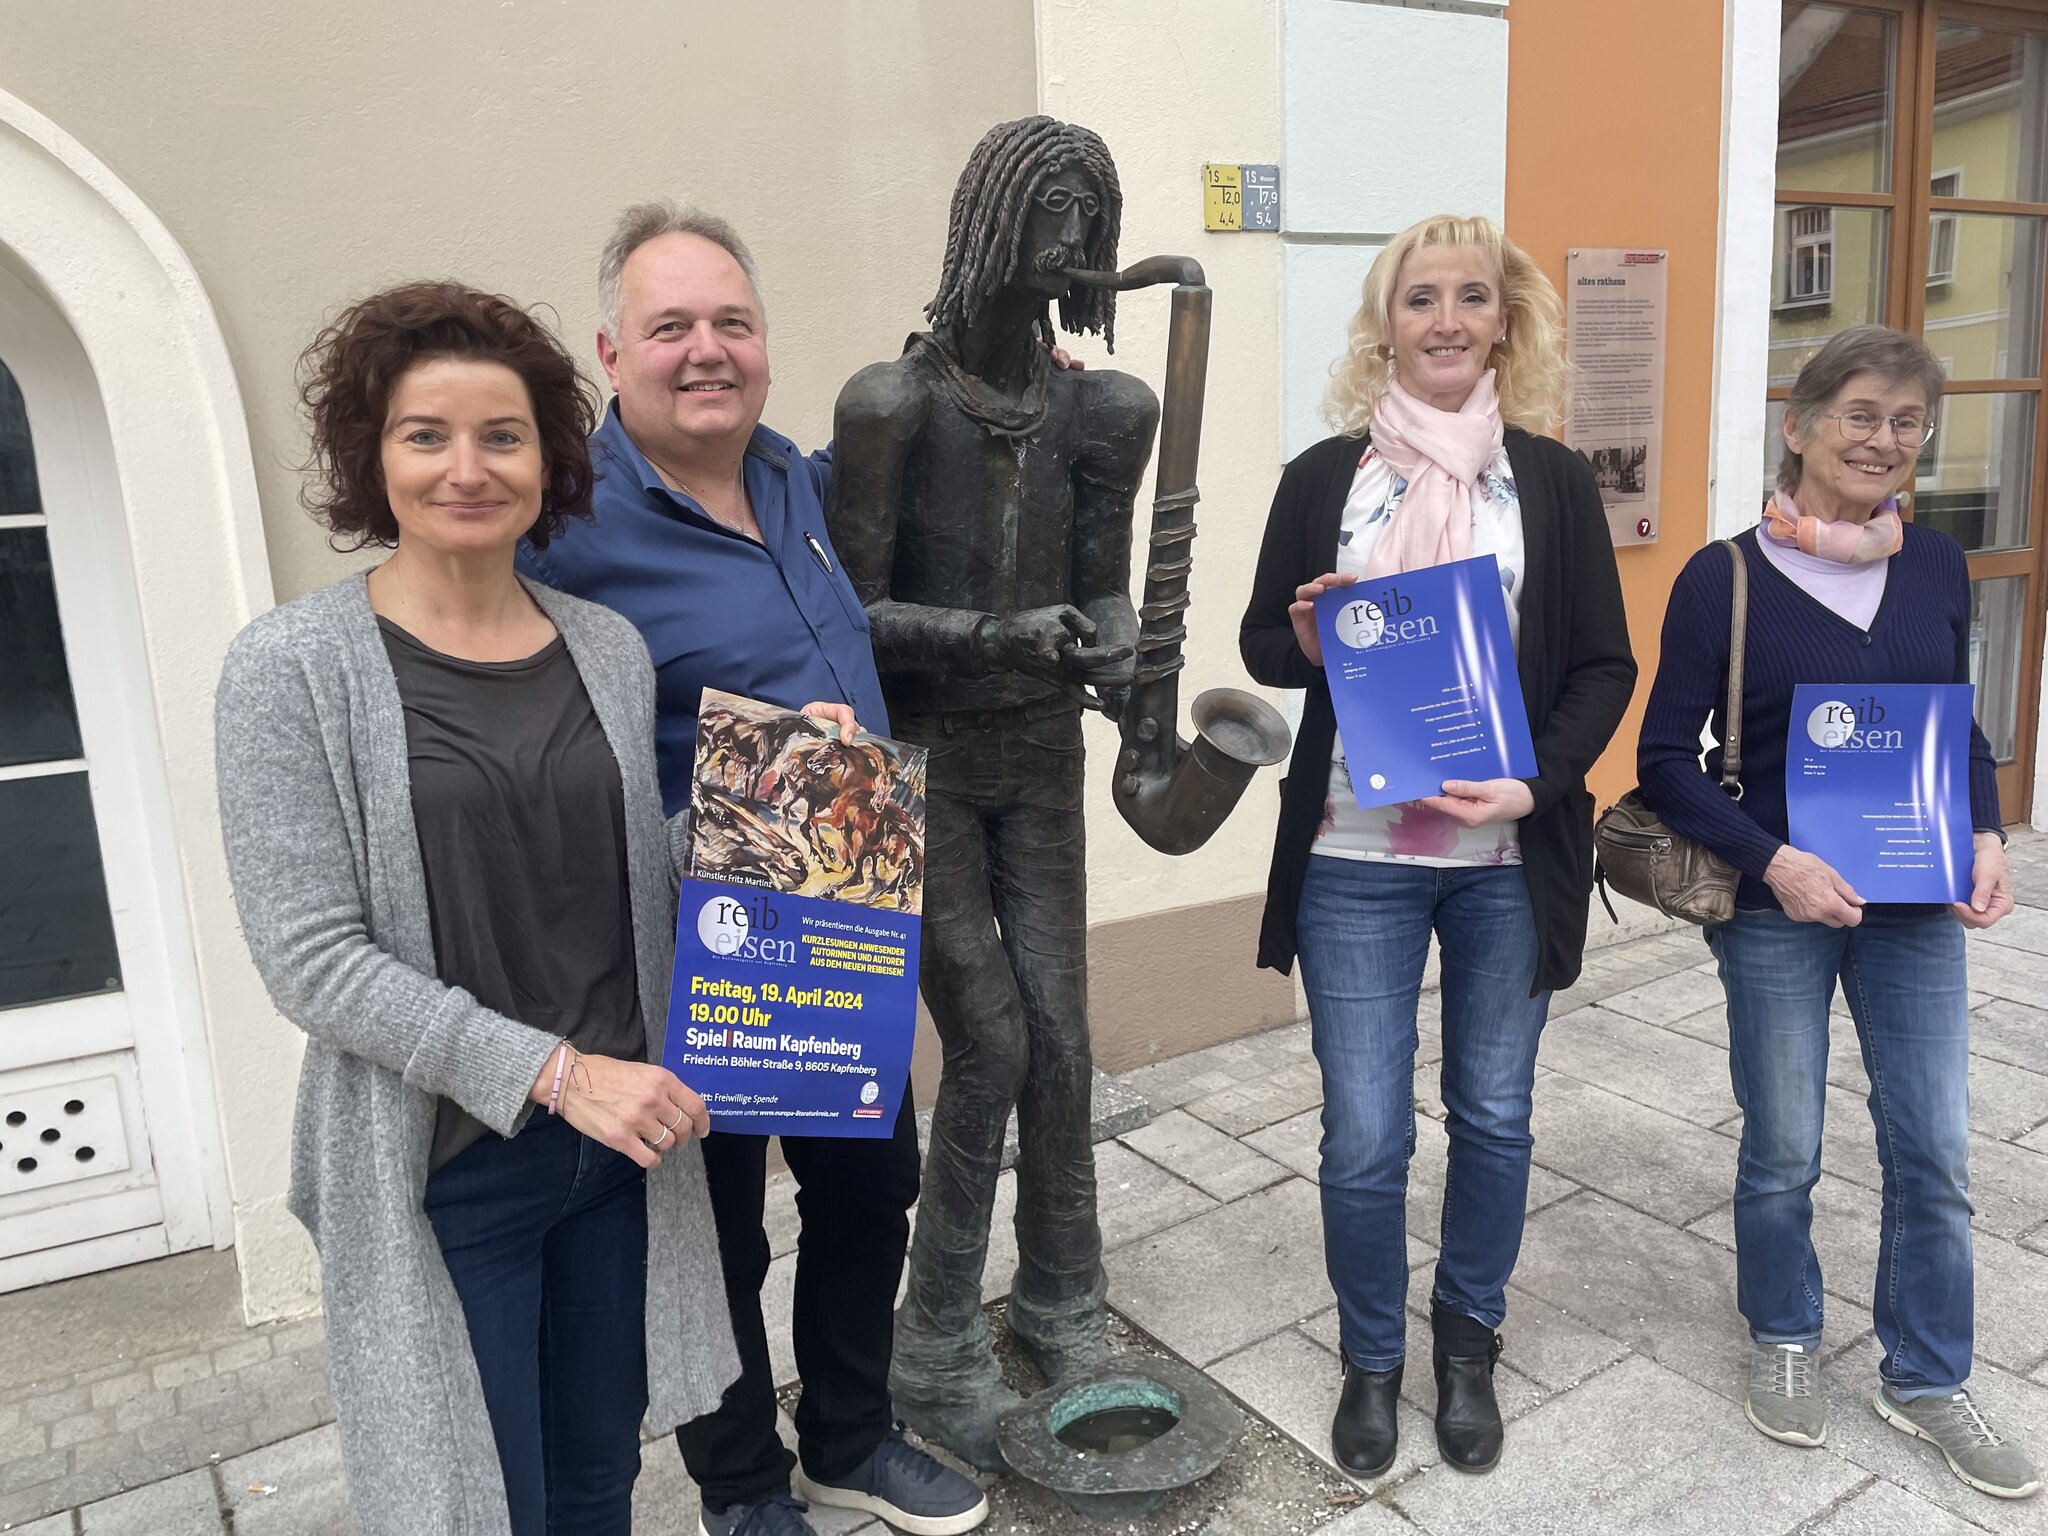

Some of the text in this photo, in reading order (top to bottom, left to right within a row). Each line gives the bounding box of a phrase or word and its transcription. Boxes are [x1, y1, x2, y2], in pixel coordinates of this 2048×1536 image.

[1226, 192, 1240, 205] 2,0
[1220, 212, 1234, 226] 4,4
[1256, 212, 1272, 226] 5,4
[1577, 276, 1626, 286] altes rathaus
[1642, 522, 1648, 533] 7
[1350, 588, 1412, 625] reib
[1356, 615, 1440, 648] eisen
[1825, 696, 1886, 725] reib
[1823, 725, 1904, 749] eisen
[697, 869, 772, 888] Künstler Fritz Martinz
[716, 896, 779, 930] reib
[802, 916, 814, 925] Wir
[815, 919, 853, 932] präsentieren
[855, 925, 864, 933] die
[864, 926, 890, 938] Ausgabe
[715, 929, 797, 964] eisen
[802, 934, 905, 956] KURZLESUNGEN ANWESENDER
[810, 958, 904, 976] AUS DEM NEUEN REIBEISEN!
[811, 946, 905, 967] AUTORINNEN UND AUTOREN
[691, 976, 863, 1010] Freitag, 19. April 2024
[689, 1003, 772, 1027] 19.00 Uhr
[780, 1034, 861, 1060] Kapfenberg
[683, 1054, 877, 1076] Friedrich Böhler Straße 9, 8605 Kapfenberg
[714, 1093, 752, 1105] Freiwillige
[753, 1094, 779, 1105] Spende
